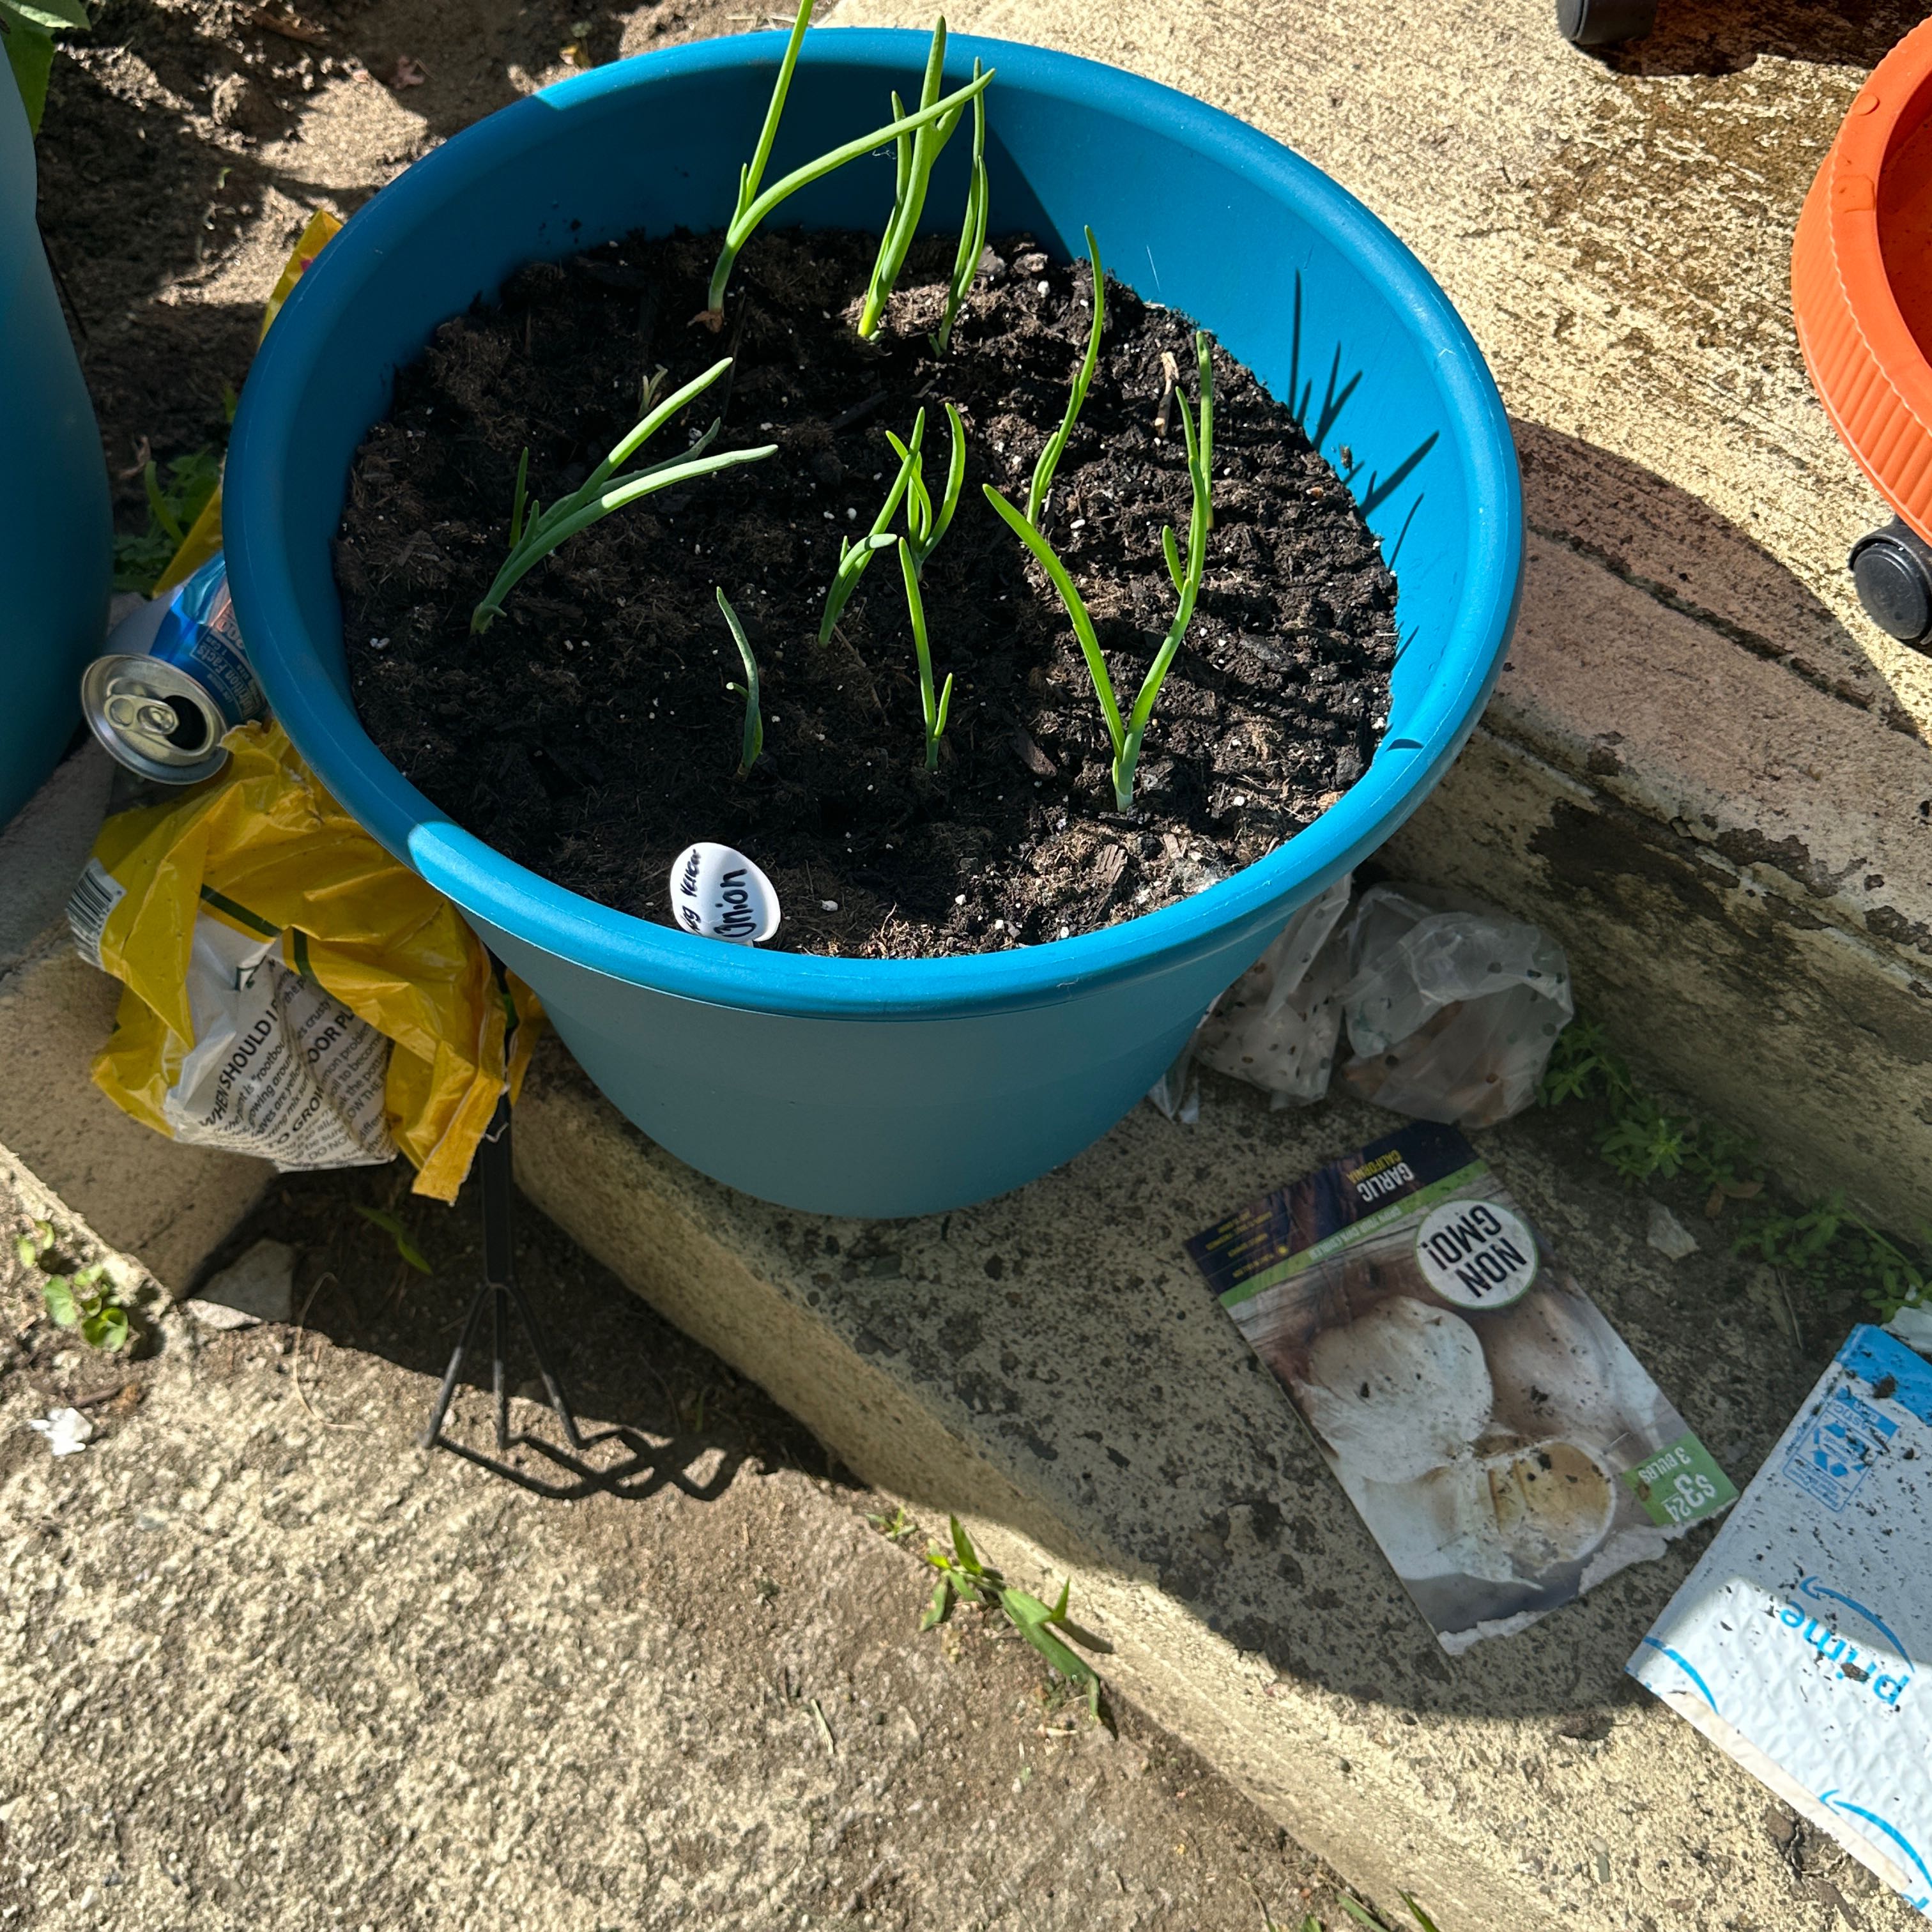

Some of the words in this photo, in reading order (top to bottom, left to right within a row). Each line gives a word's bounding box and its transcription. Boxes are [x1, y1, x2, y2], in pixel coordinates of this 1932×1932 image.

[204, 635, 221, 650] Can
[195, 643, 227, 674] Facts
[224, 669, 252, 717] Nutrition
[713, 868, 757, 937] Onion
[303, 999, 331, 1028] crusty
[197, 1084, 229, 1126] WHEN
[216, 1016, 273, 1089] SHOULD
[264, 1009, 279, 1022] I
[338, 1068, 352, 1082] to
[272, 1089, 289, 1111] are
[344, 1078, 364, 1096] the
[360, 1080, 382, 1101] THE
[306, 1144, 328, 1161] DO
[1345, 1148, 1402, 1184] CALIFORNIA
[1355, 1160, 1415, 1202] GARLIC
[1418, 1202, 1501, 1271] GMO!
[1453, 1234, 1527, 1298] NON
[1637, 1452, 1678, 1483] BULBS
[1673, 1445, 1691, 1466] 3
